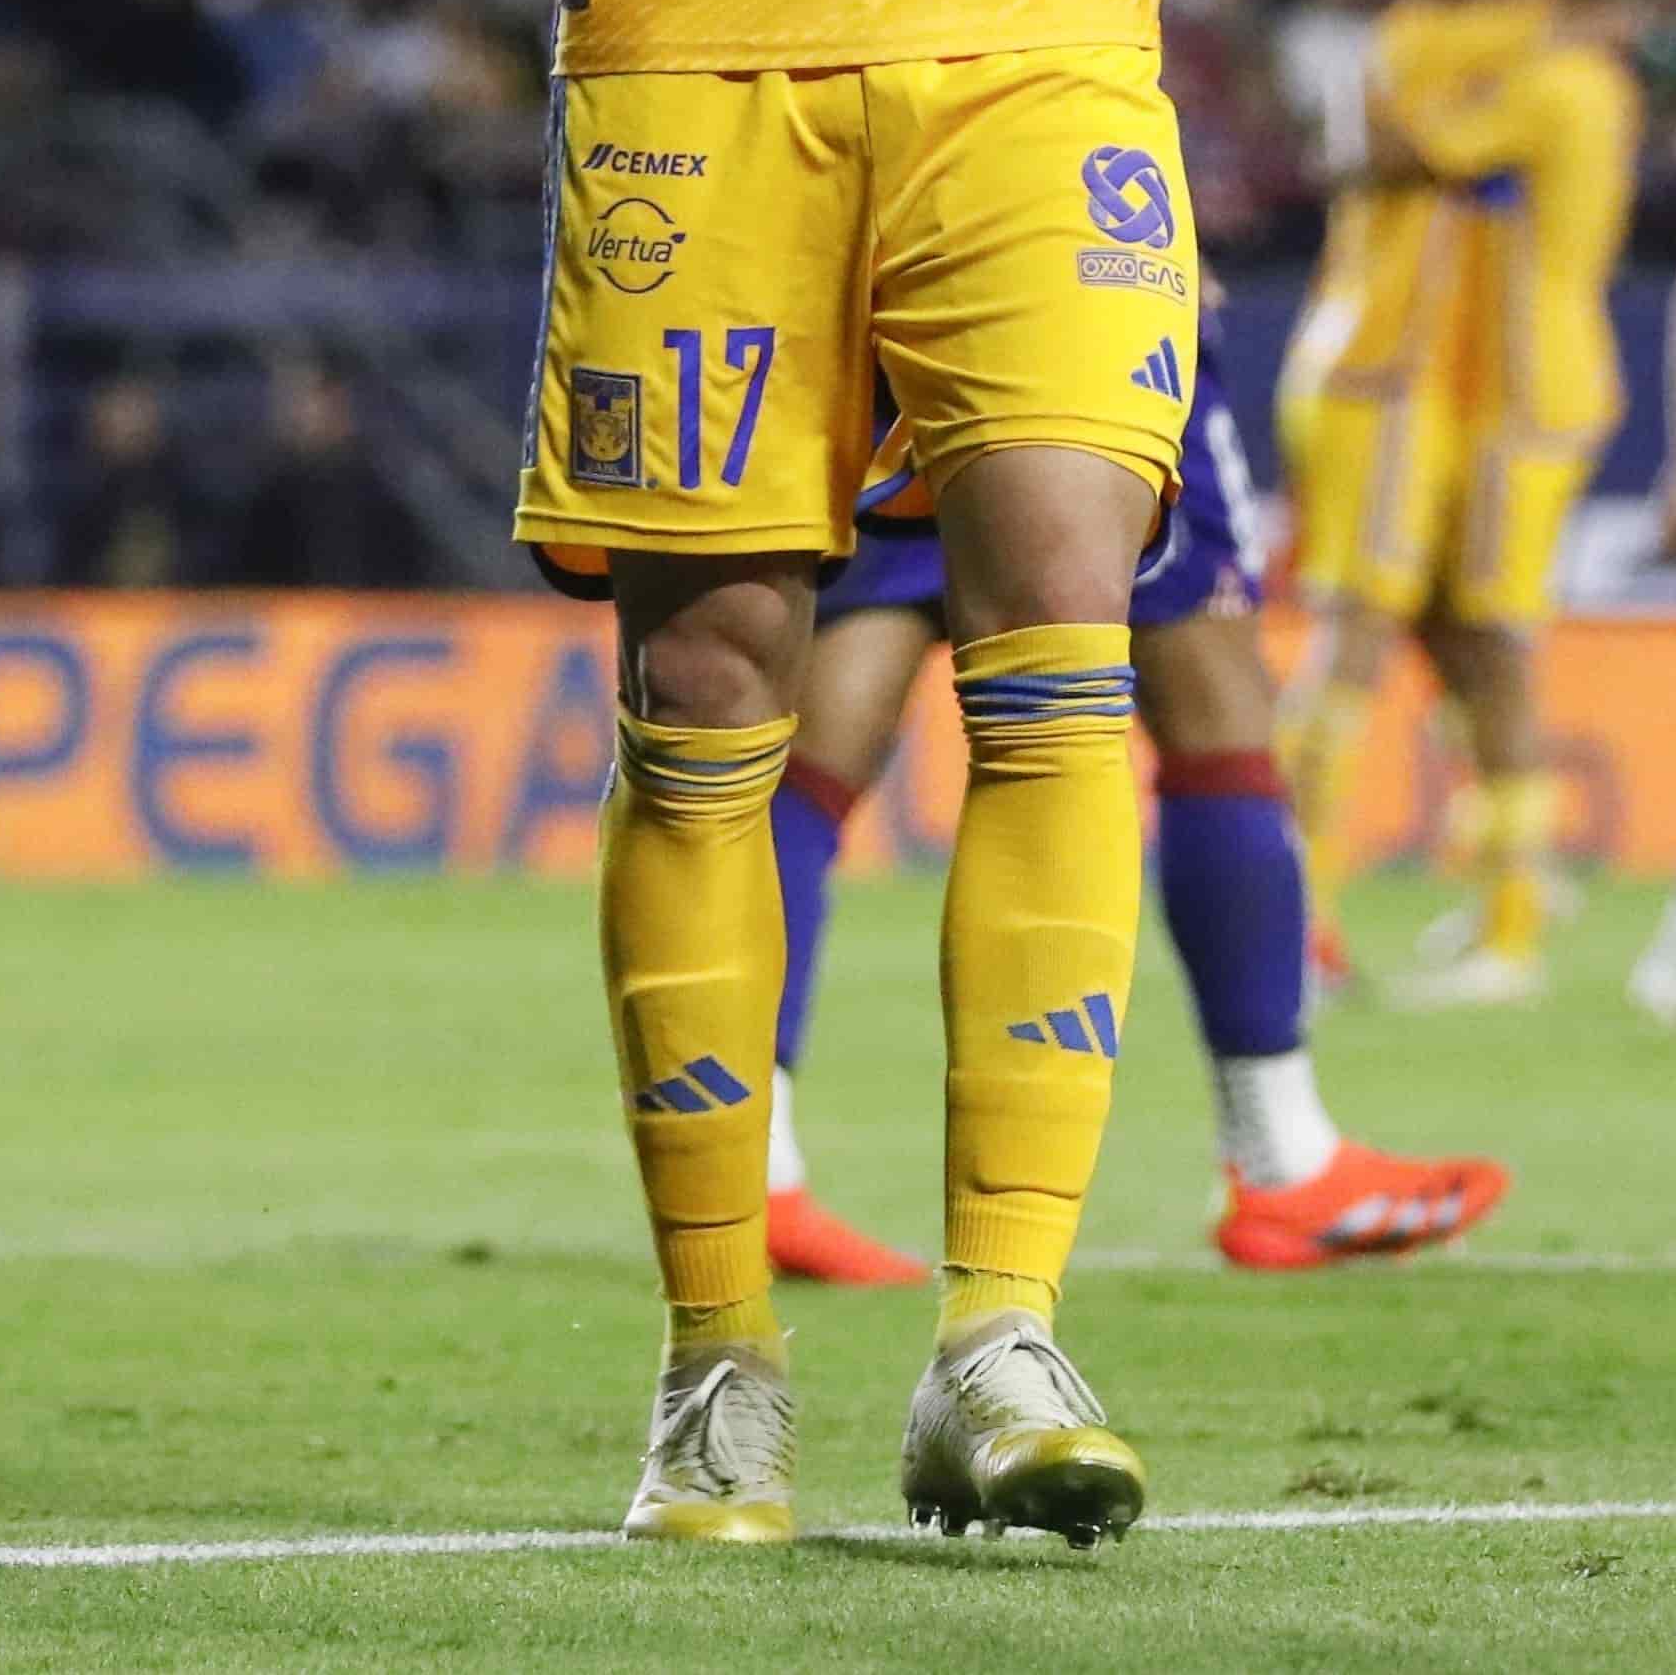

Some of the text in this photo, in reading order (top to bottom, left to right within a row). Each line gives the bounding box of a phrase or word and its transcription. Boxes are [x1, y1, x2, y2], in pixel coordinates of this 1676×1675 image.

[611, 150, 708, 177] CEMEX
[587, 226, 673, 263] Vertua
[1139, 260, 1186, 297] GAS
[663, 326, 775, 490] 17
